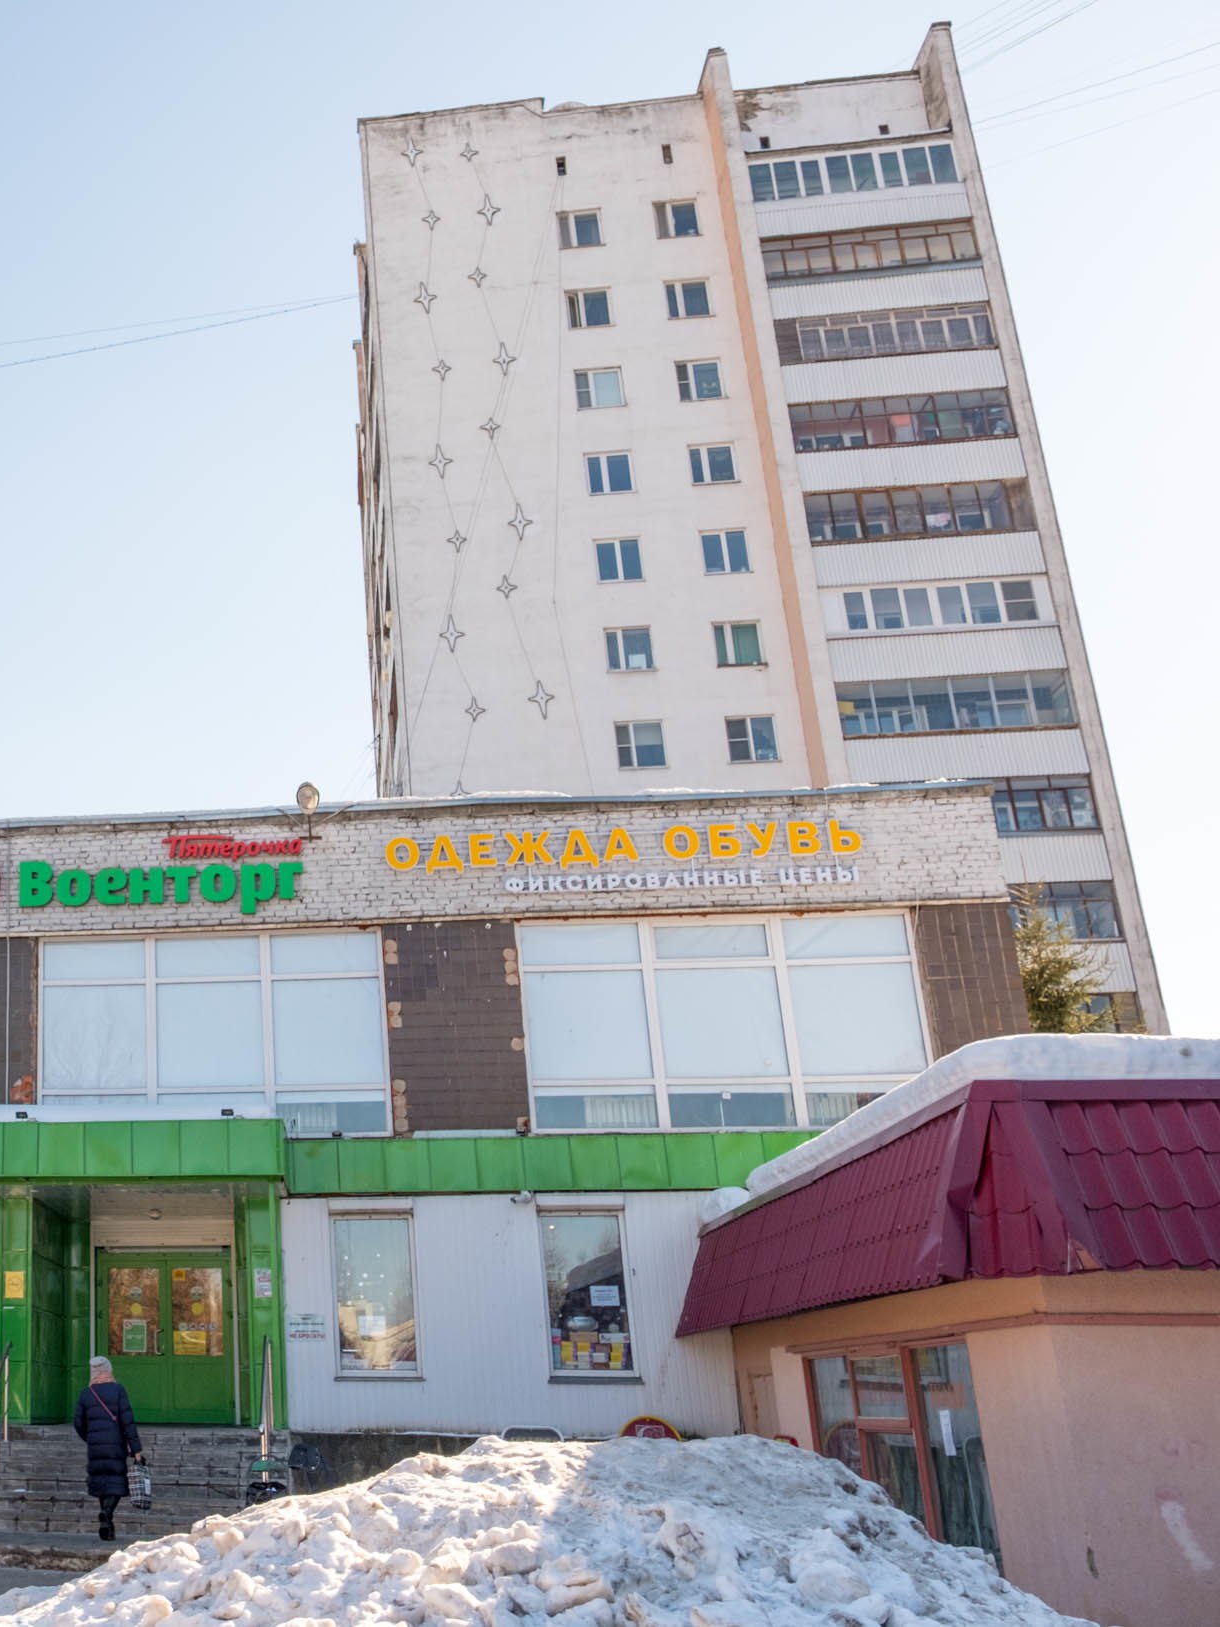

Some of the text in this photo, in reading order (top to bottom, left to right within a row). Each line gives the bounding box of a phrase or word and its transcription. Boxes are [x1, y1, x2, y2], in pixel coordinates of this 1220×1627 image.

[161, 834, 303, 862] Пятерочка
[385, 820, 861, 874] ОДЕЖДА ОБУВЬ
[19, 861, 303, 915] Военторг
[504, 866, 861, 893] ФИКСИРОВАННЫЕ ЦЕНЫ
